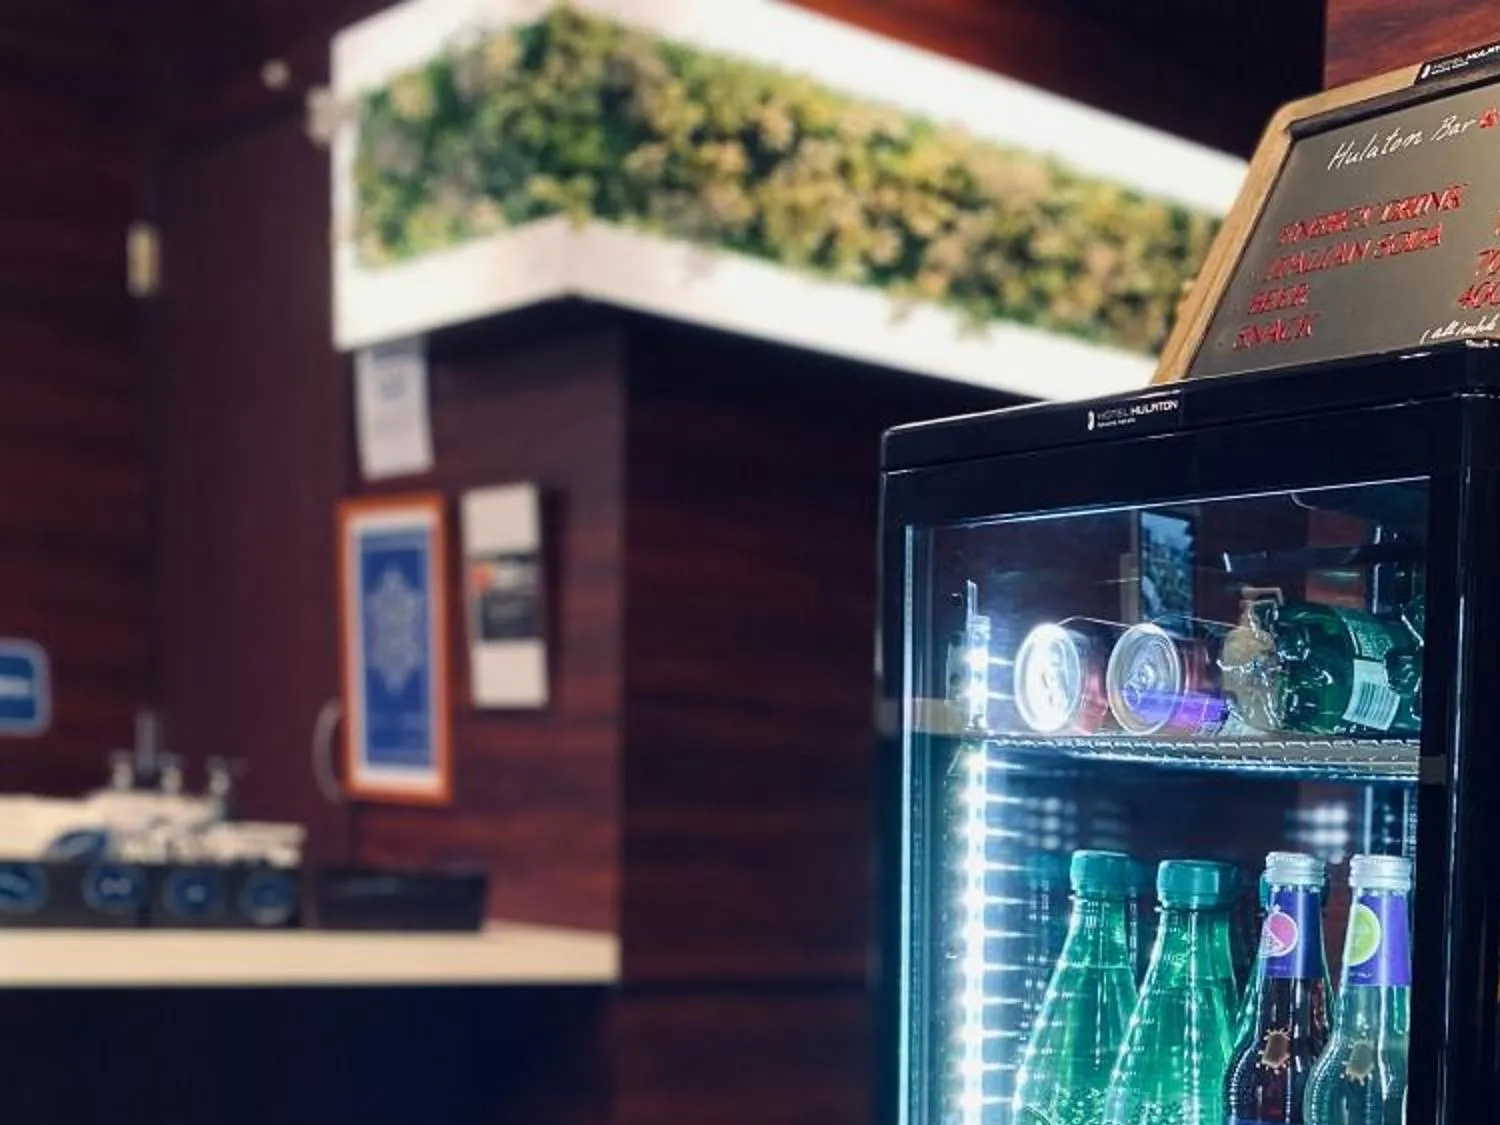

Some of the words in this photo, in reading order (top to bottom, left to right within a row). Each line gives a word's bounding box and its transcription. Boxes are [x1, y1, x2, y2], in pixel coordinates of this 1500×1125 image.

[1328, 127, 1424, 171] Hulaton
[1430, 114, 1476, 141] Bar
[1131, 399, 1179, 416] HULATON
